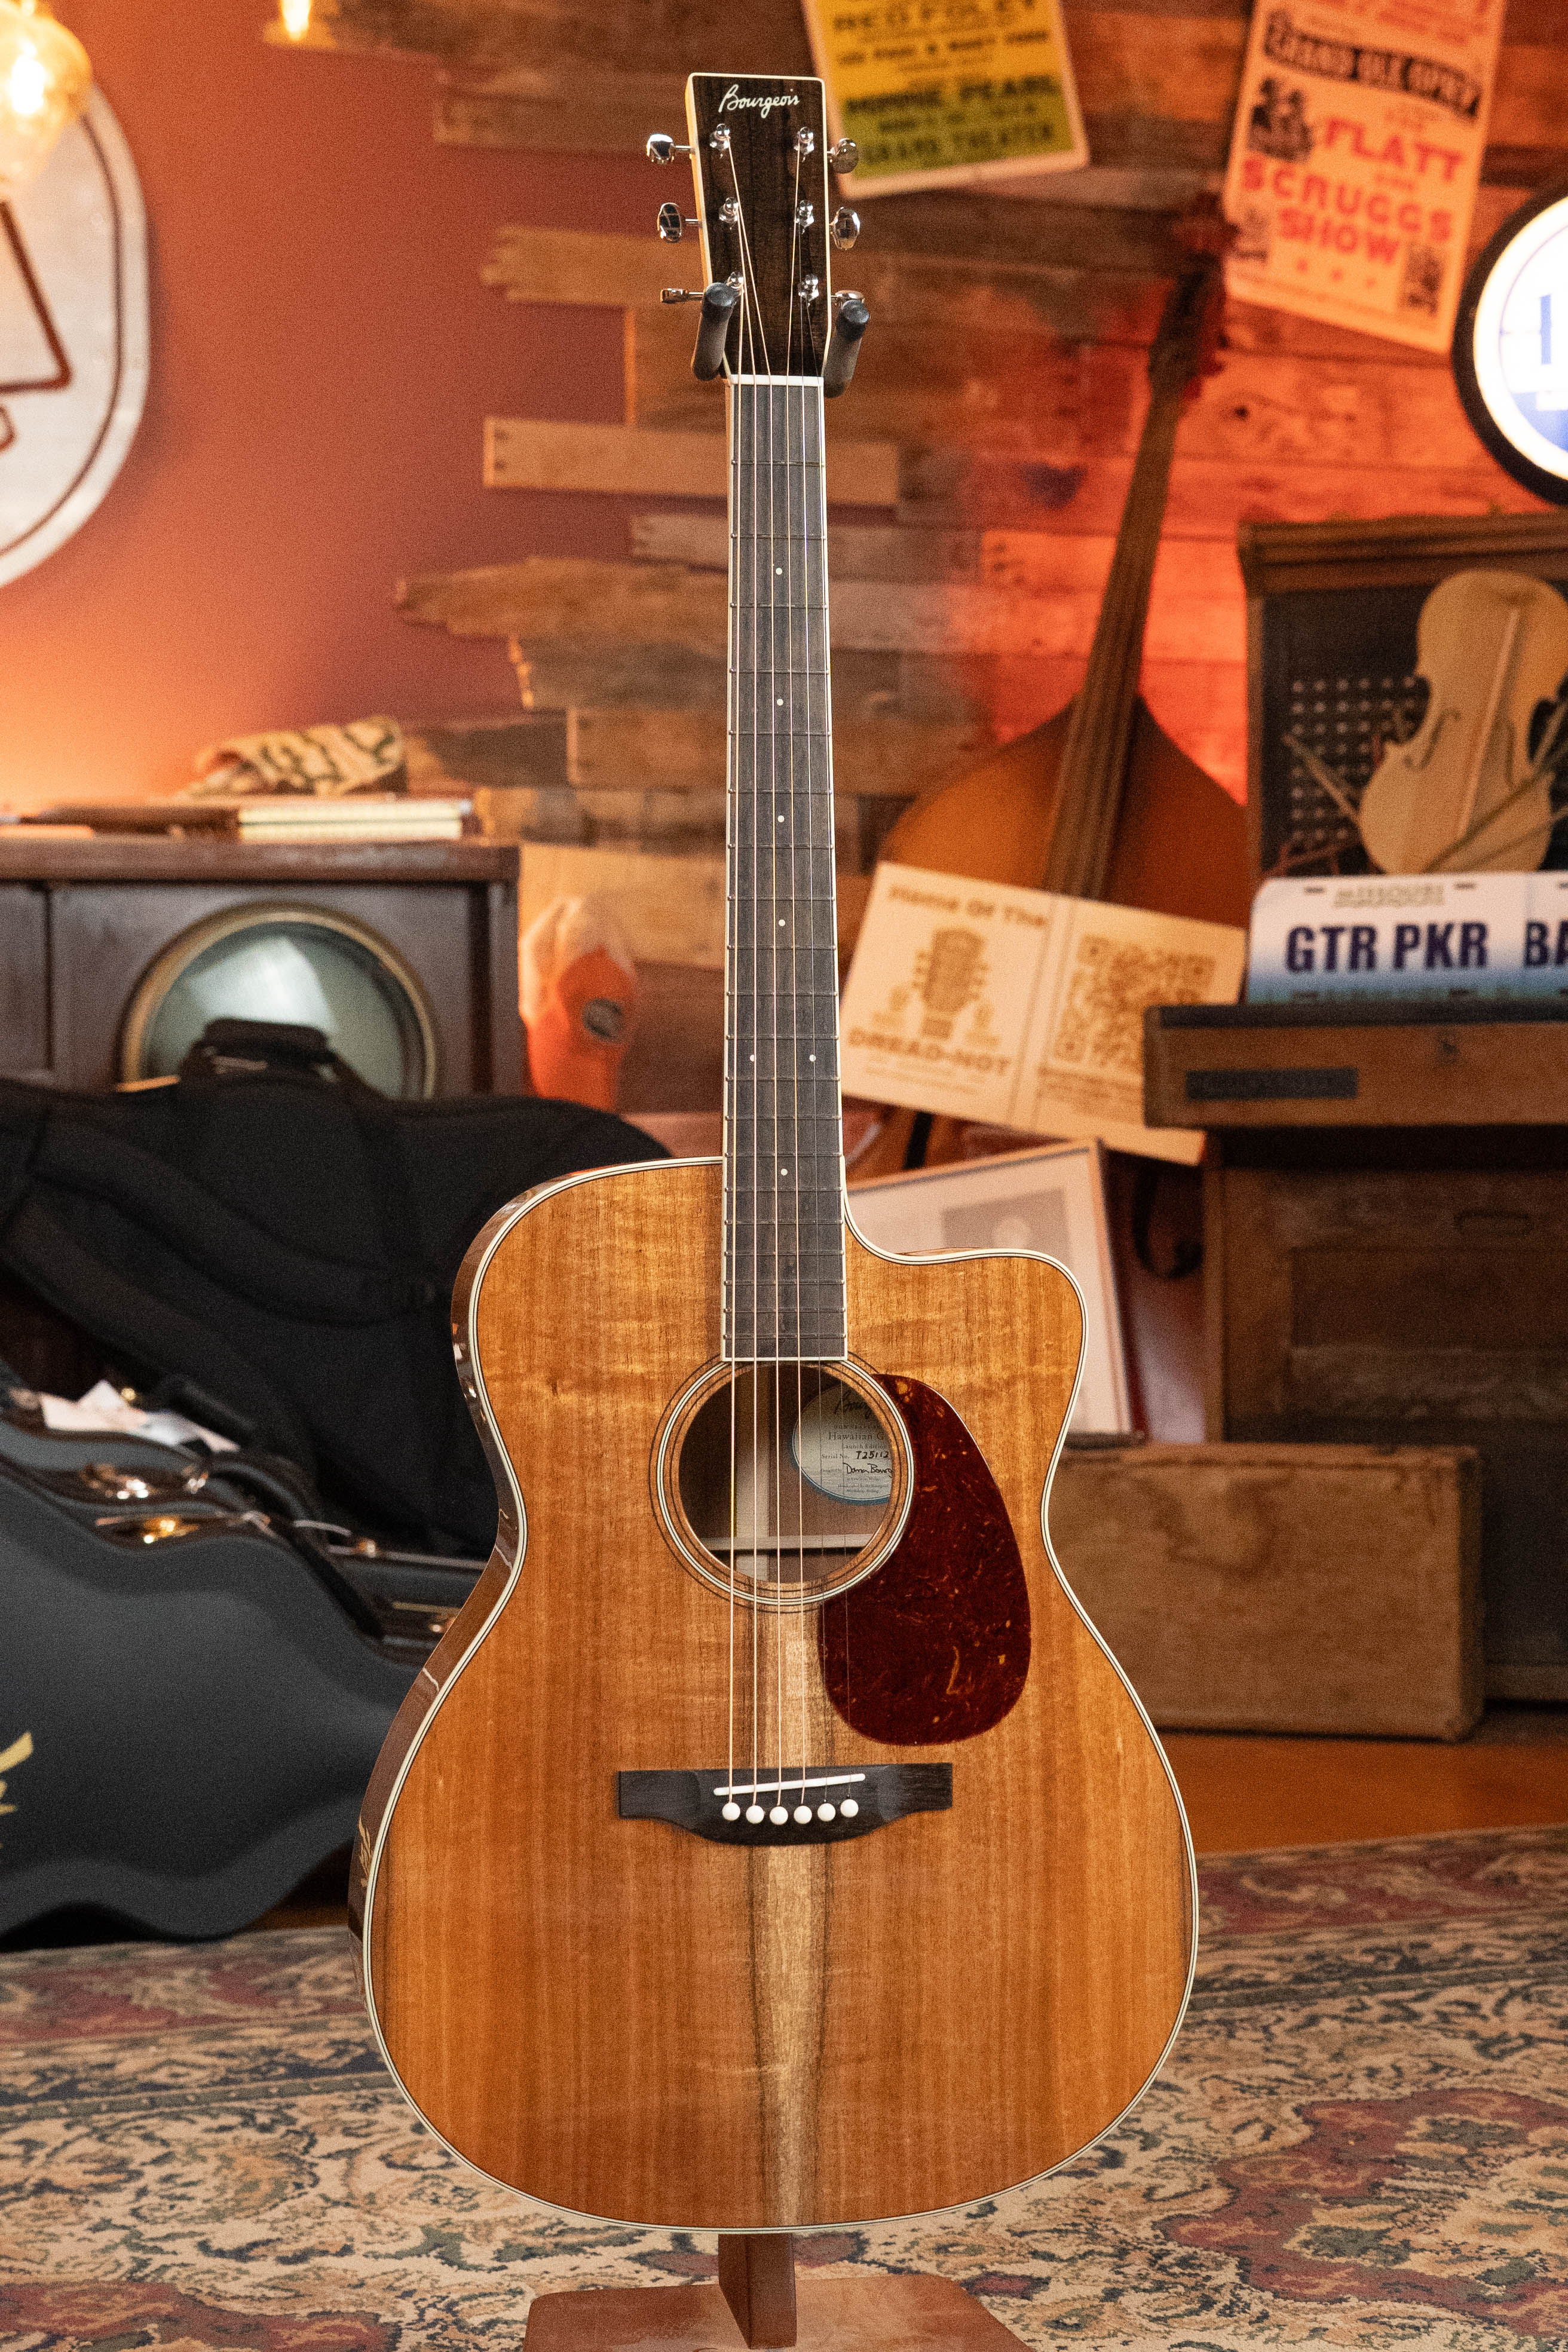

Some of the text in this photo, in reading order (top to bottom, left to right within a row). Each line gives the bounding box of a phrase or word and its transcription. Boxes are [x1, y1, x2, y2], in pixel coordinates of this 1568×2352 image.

[718, 84, 800, 118] Bourgeois
[1324, 117, 1465, 184] FLATT
[1241, 157, 1453, 243] SCRUGGS
[1278, 207, 1401, 266] SHOW
[1286, 921, 1489, 973] GTR PKR
